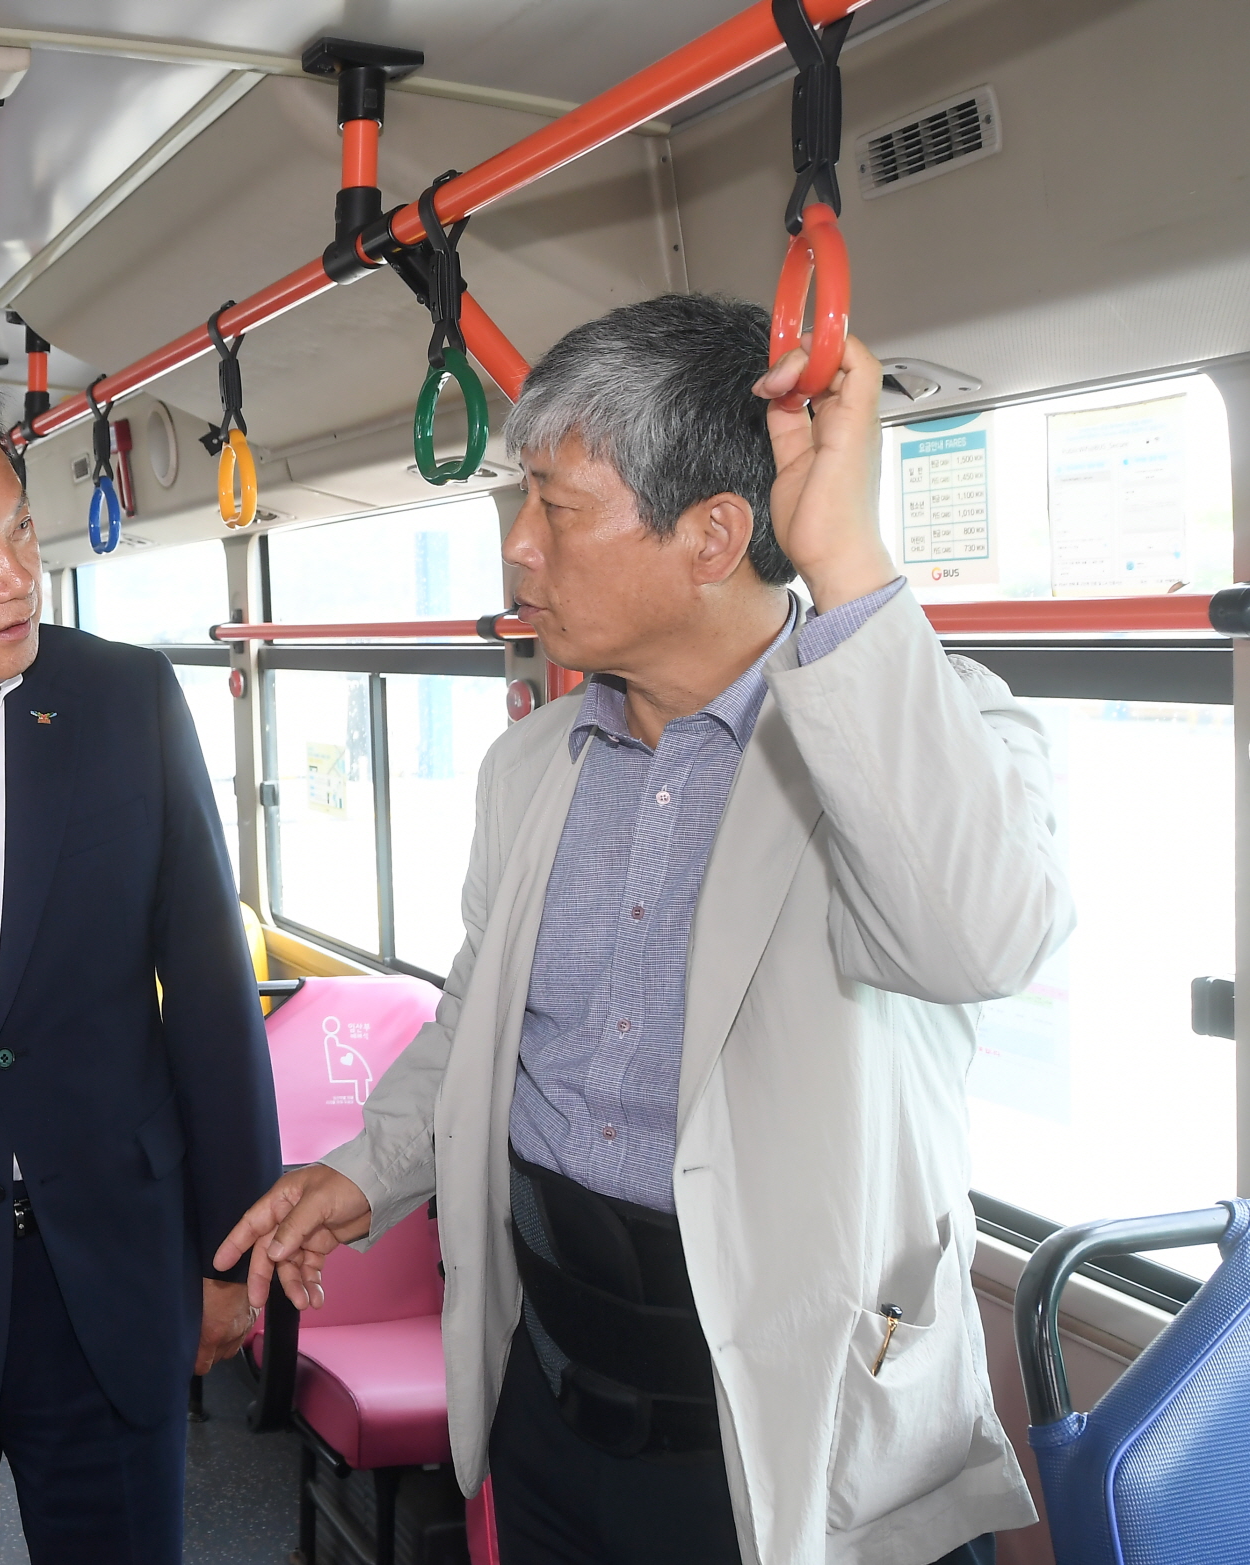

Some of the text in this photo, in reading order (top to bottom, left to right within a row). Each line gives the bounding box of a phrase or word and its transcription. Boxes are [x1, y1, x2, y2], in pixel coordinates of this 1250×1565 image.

[919, 437, 967, 453] 요금안내 FARES
[956, 455, 973, 464] 1,500
[957, 474, 974, 482] 1,450
[957, 491, 974, 500] 1,100
[910, 501, 924, 511] 청소년
[958, 509, 975, 518] 1,010
[963, 527, 975, 535] 800
[910, 536, 925, 545] 어린이
[964, 544, 976, 552] 730
[943, 568, 959, 578] BUS
[348, 1023, 371, 1034] 임산부
